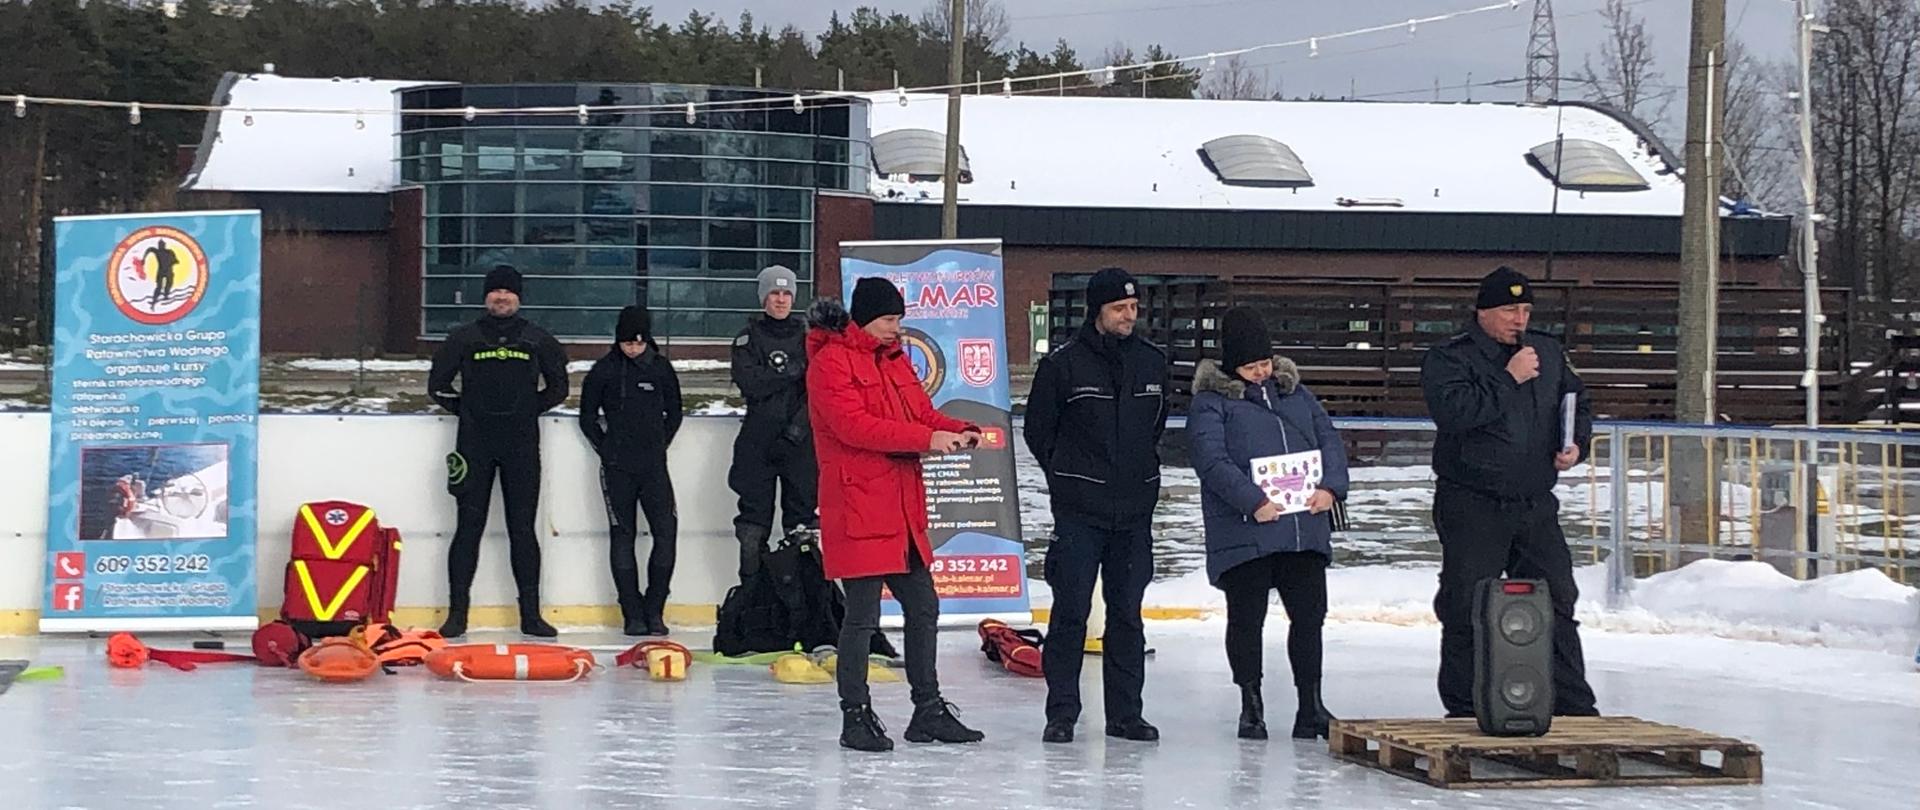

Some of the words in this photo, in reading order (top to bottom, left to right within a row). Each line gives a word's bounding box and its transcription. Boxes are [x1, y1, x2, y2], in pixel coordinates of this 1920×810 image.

[898, 284, 998, 308] LMAR
[89, 332, 183, 344] Starachowicka
[186, 330, 226, 342] Grupa
[86, 348, 166, 360] Ratownictwa
[169, 345, 229, 357] Wodnego
[105, 363, 170, 377] organizuje
[173, 361, 206, 372] kursy
[116, 375, 206, 388] motorowodnego
[147, 416, 200, 427] pierwszej
[96, 557, 130, 573] 609
[136, 557, 169, 572] 352
[176, 556, 208, 571] 242
[948, 559, 977, 572] 352
[980, 558, 1008, 572] 242
[659, 655, 672, 678] 1
